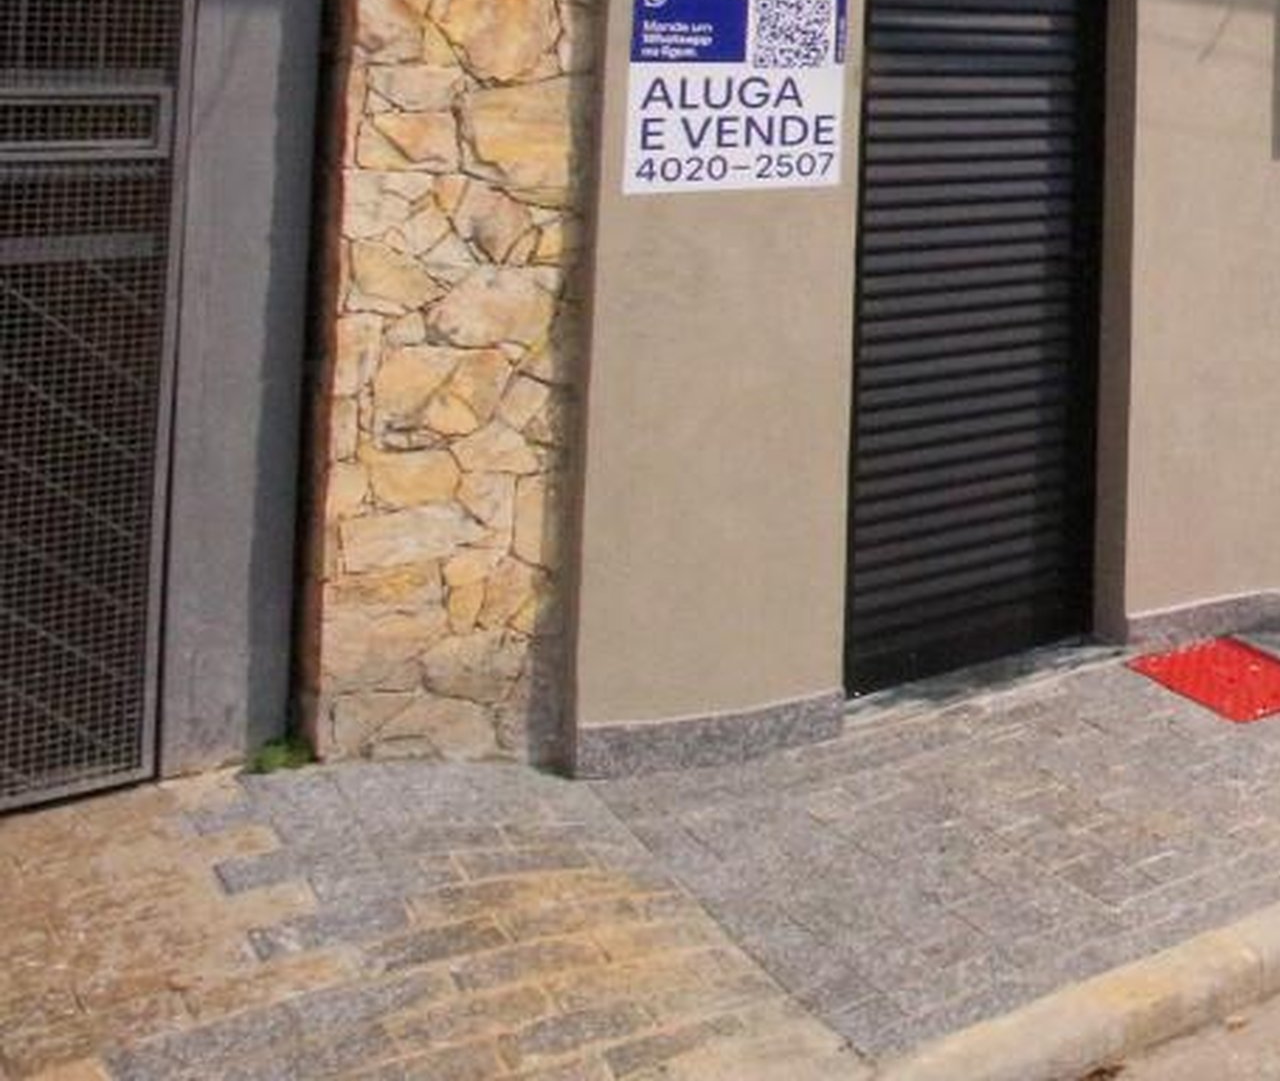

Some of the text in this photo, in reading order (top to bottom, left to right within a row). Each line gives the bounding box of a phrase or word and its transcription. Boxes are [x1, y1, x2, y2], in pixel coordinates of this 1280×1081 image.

[641, 76, 803, 110] ALUGA
[640, 114, 835, 151] E VENDE
[635, 152, 834, 182] 4020-2507
